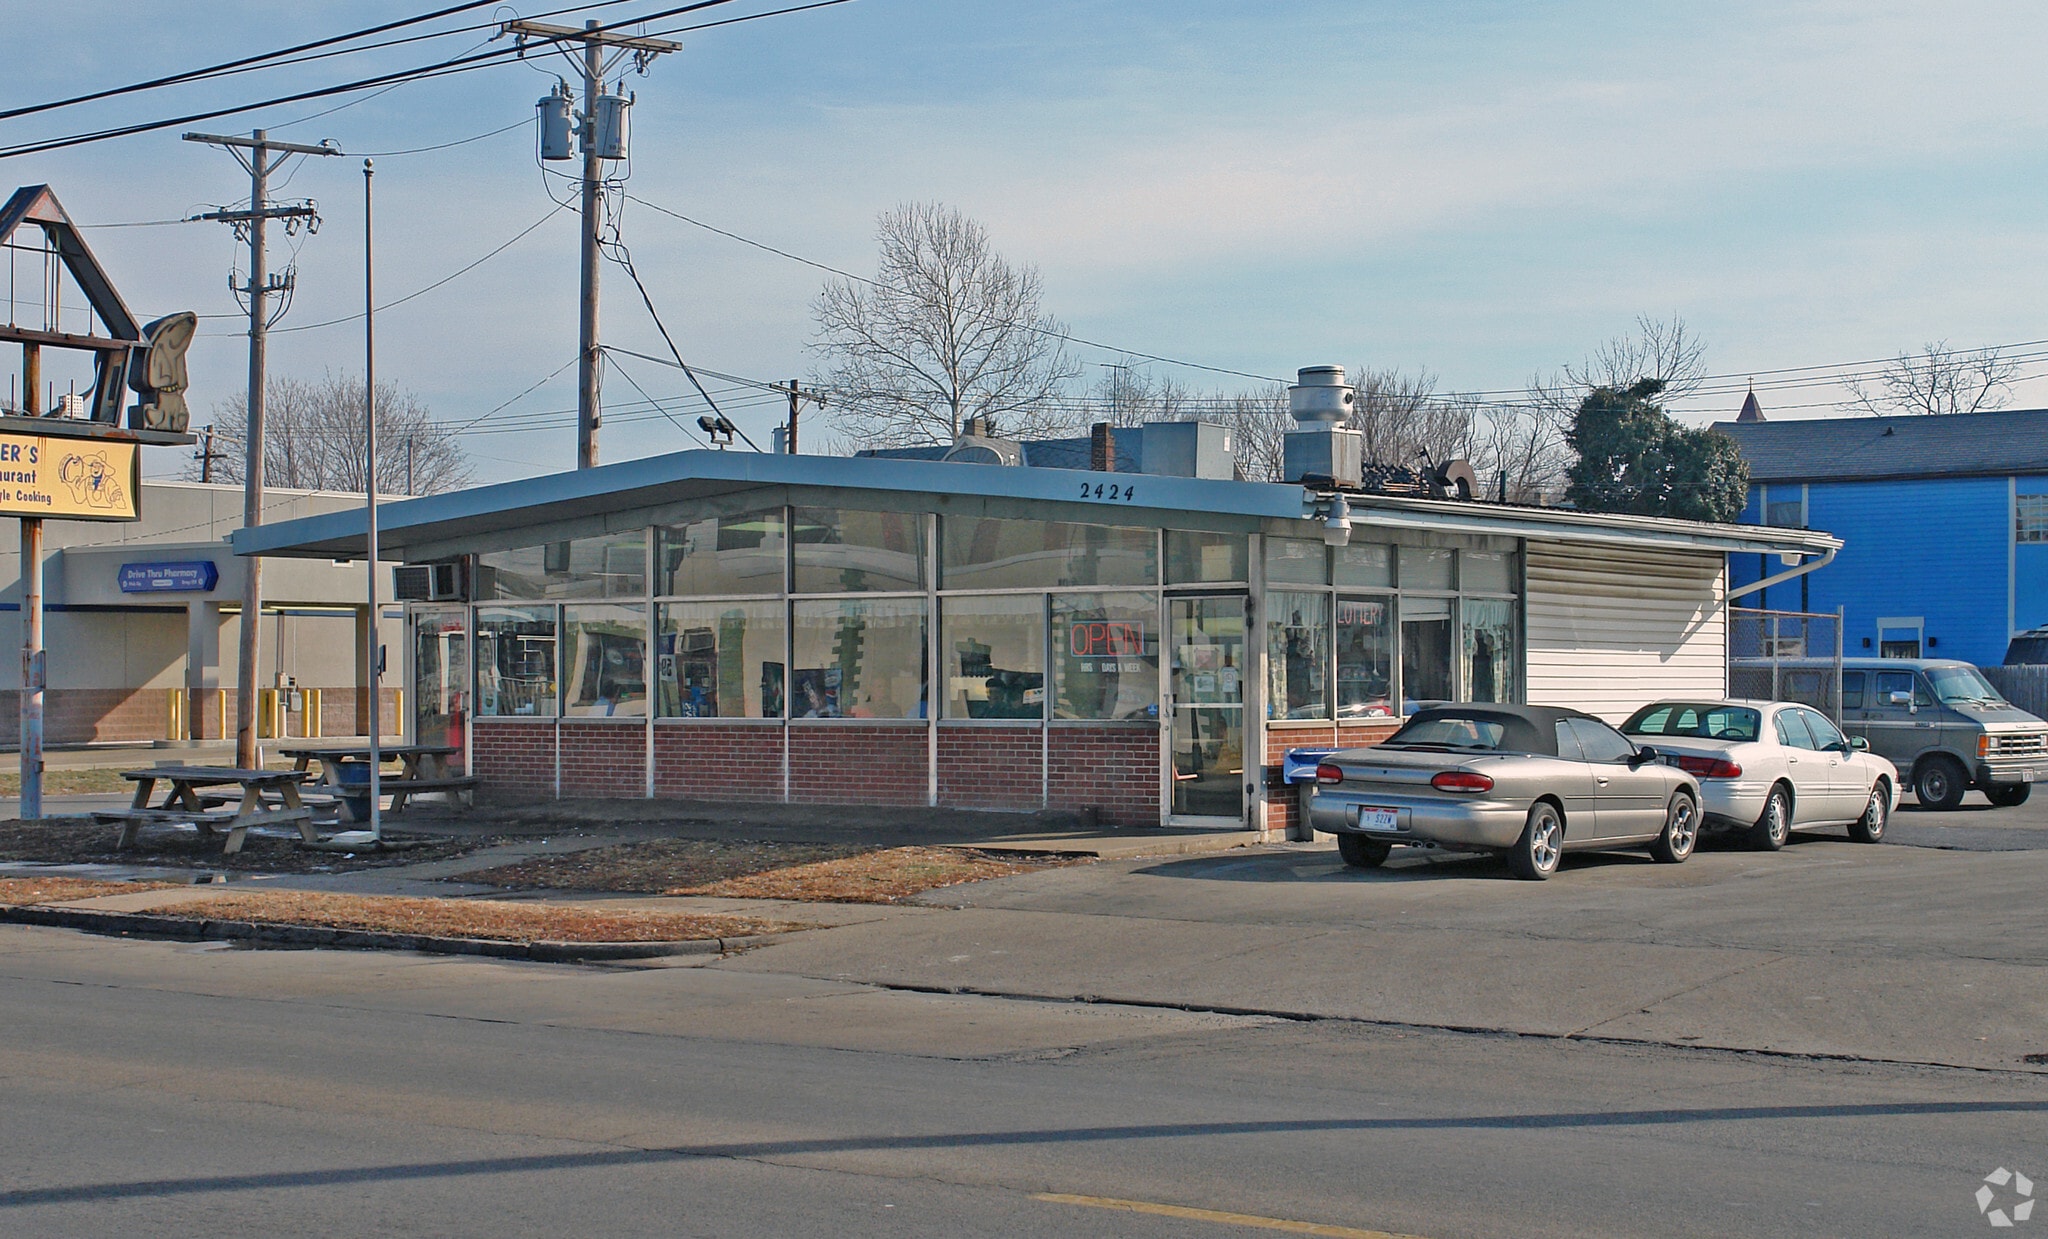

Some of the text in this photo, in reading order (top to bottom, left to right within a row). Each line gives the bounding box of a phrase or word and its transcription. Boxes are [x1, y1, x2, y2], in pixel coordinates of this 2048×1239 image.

[16, 489, 52, 506] Cooking
[1080, 482, 1135, 502] 2424
[127, 568, 198, 579] Drive Thru Pharmacy
[1337, 600, 1385, 625] LOTTERY
[1072, 623, 1143, 656] OPEN
[1101, 662, 1117, 673] DAYS
[1123, 662, 1142, 673] WEEK
